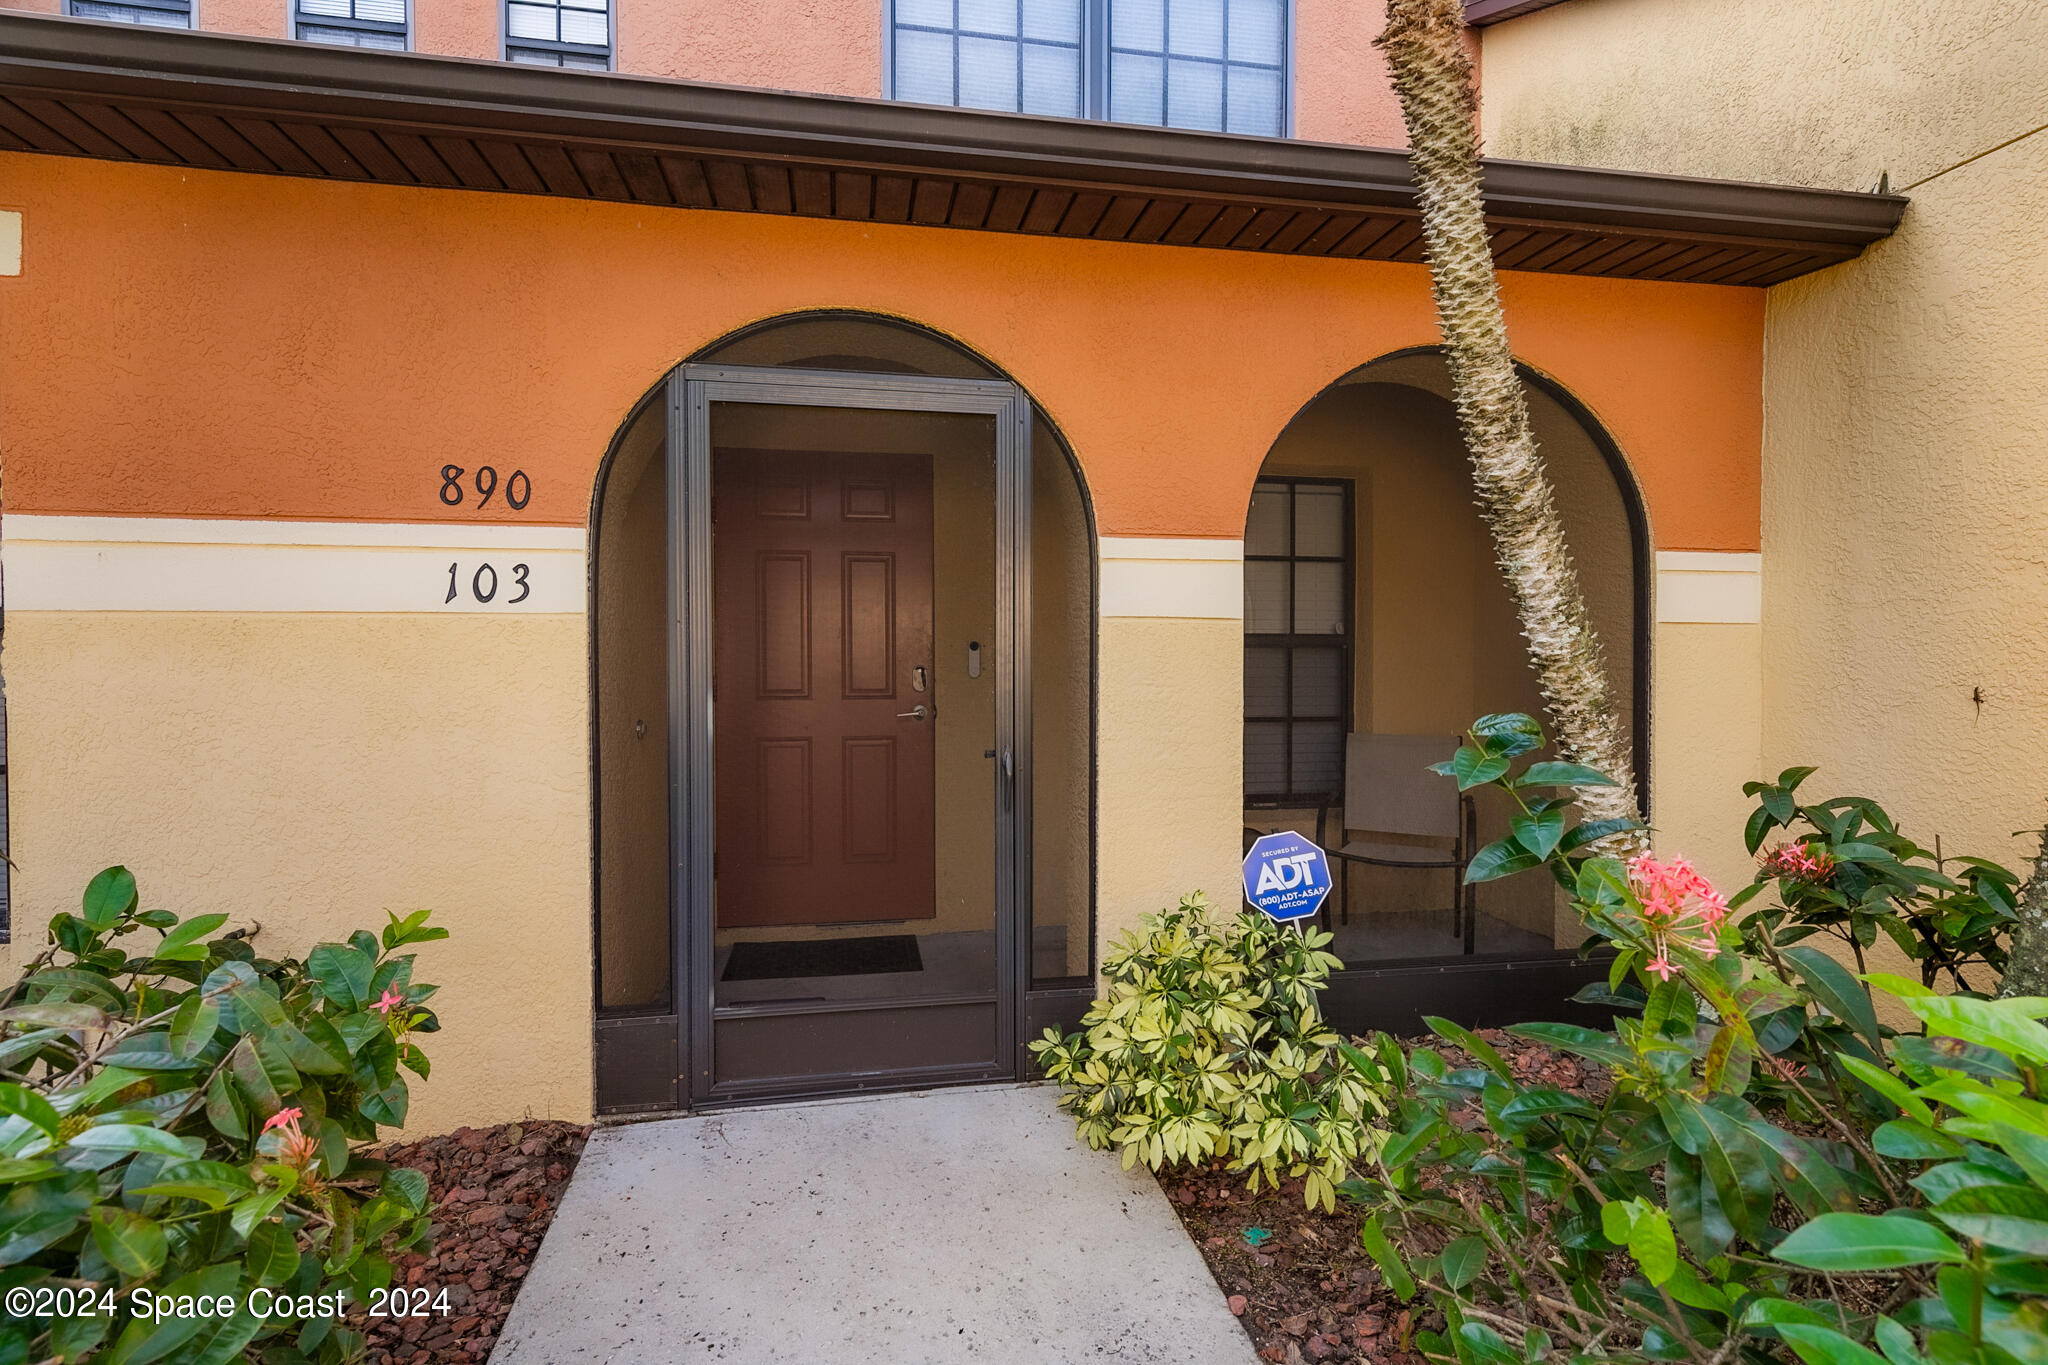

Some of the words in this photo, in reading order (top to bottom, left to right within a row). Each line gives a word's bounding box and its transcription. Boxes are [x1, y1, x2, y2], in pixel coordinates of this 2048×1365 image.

[439, 464, 532, 511] 890
[444, 562, 530, 604] 103
[1262, 848, 1290, 857] SECURED
[1255, 852, 1317, 895] ADT
[1258, 895, 1281, 907] (800)
[1280, 887, 1325, 901] ADT-ASAP
[1278, 900, 1307, 909] ADT.COM
